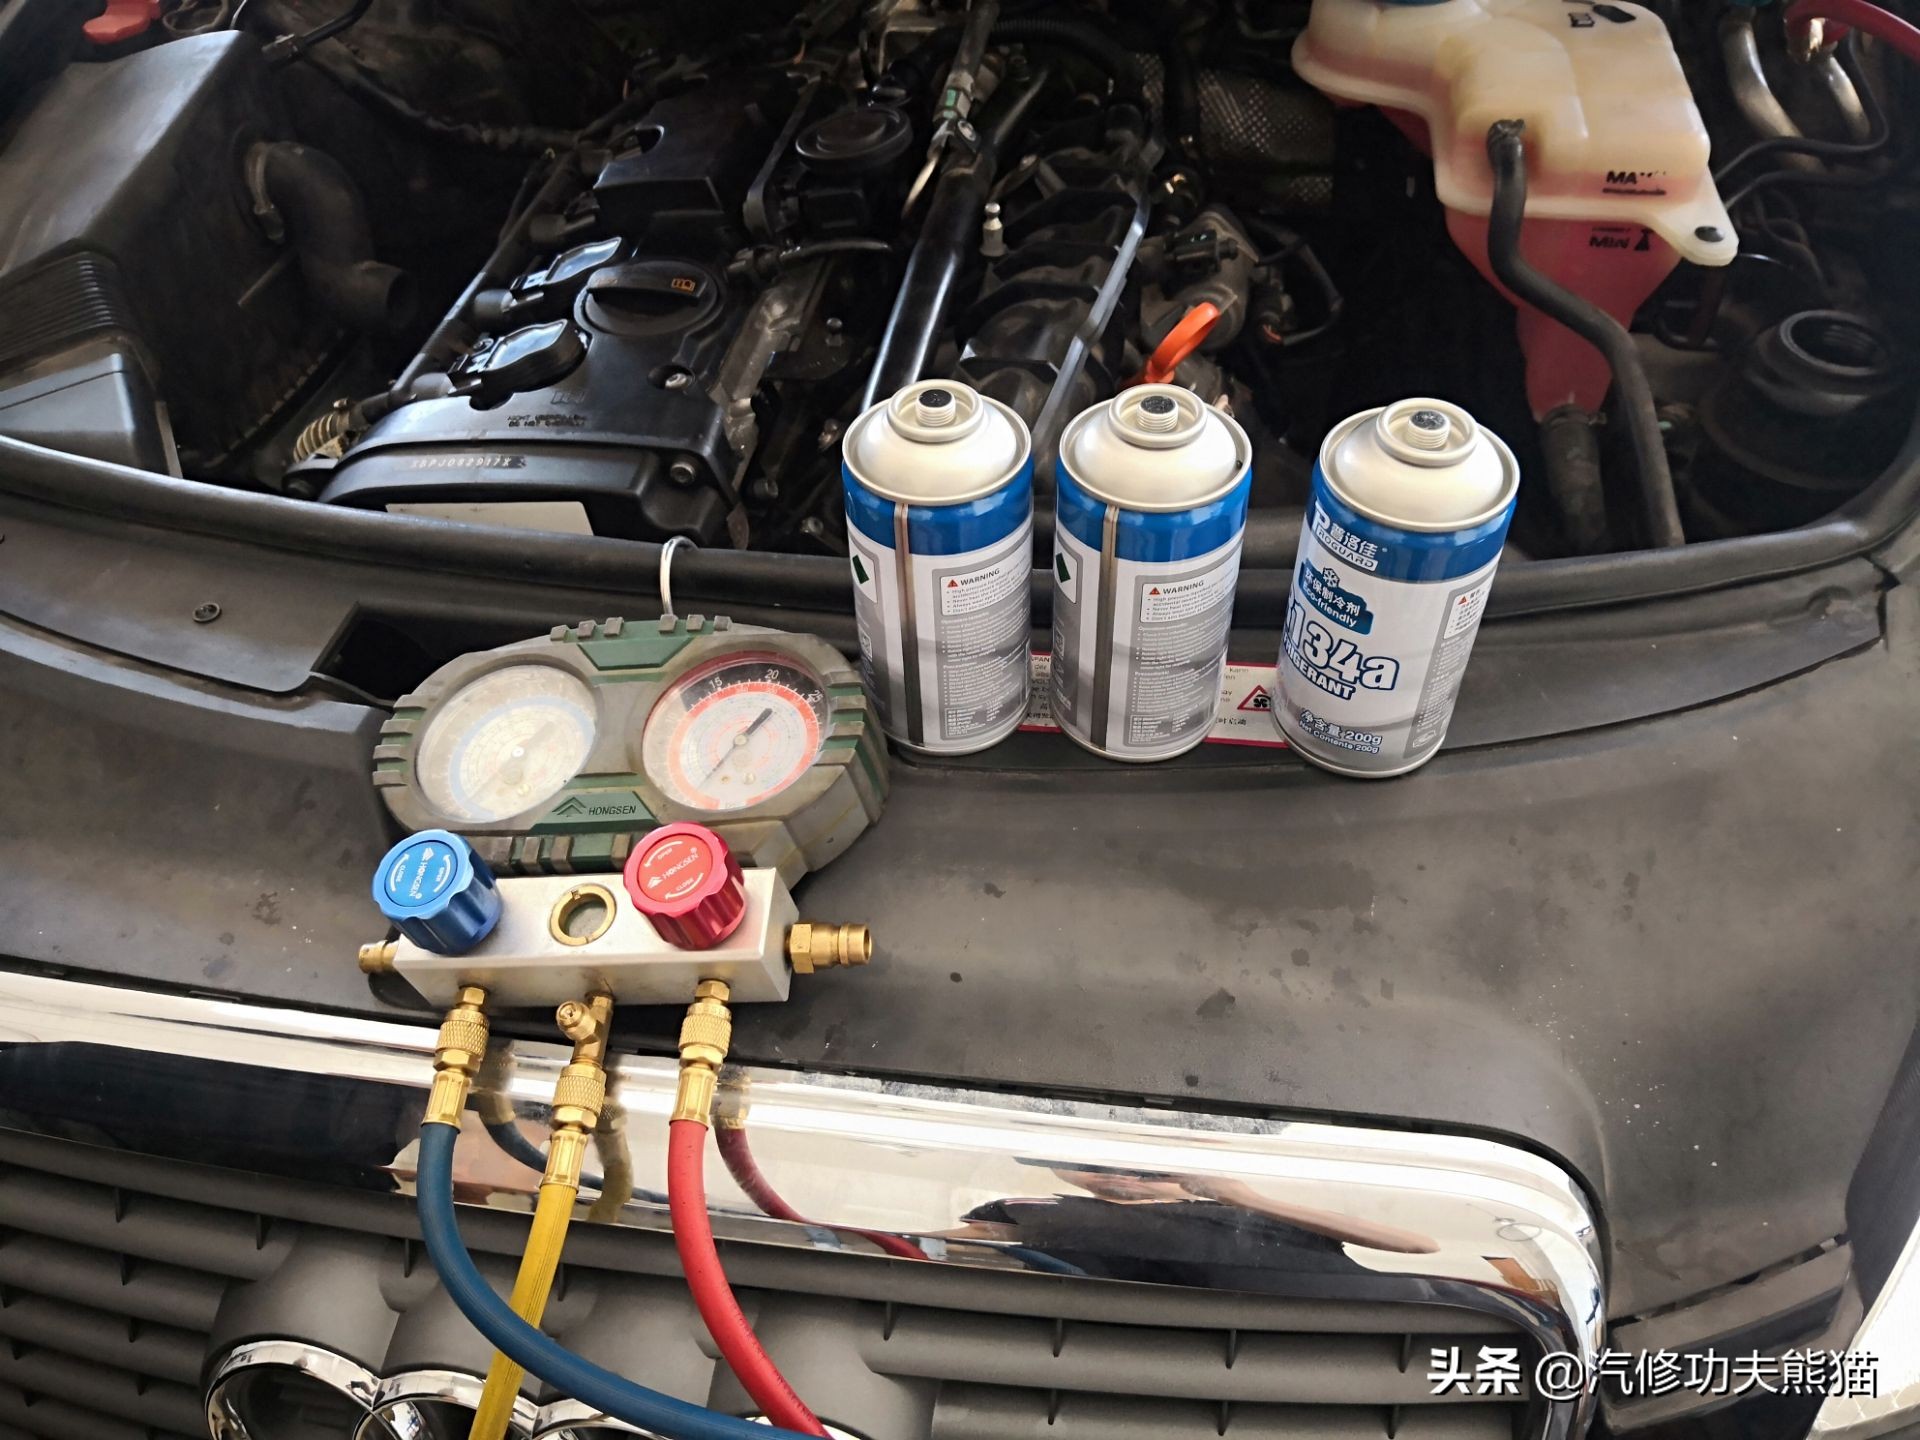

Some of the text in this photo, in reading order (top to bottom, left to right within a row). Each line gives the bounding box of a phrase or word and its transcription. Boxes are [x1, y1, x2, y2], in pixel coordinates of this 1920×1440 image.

[1606, 170, 1653, 184] MA
[1330, 523, 1378, 559] 普洛佳
[960, 567, 1000, 587] WARNING
[1163, 581, 1204, 595] WARNING
[764, 668, 780, 681] 20
[708, 676, 724, 691] 15
[807, 689, 824, 704] 25
[1345, 730, 1382, 745] 200g
[1355, 744, 1379, 754] 200g
[588, 805, 637, 816] HONGSEN
[662, 853, 699, 880] HONGSEN
